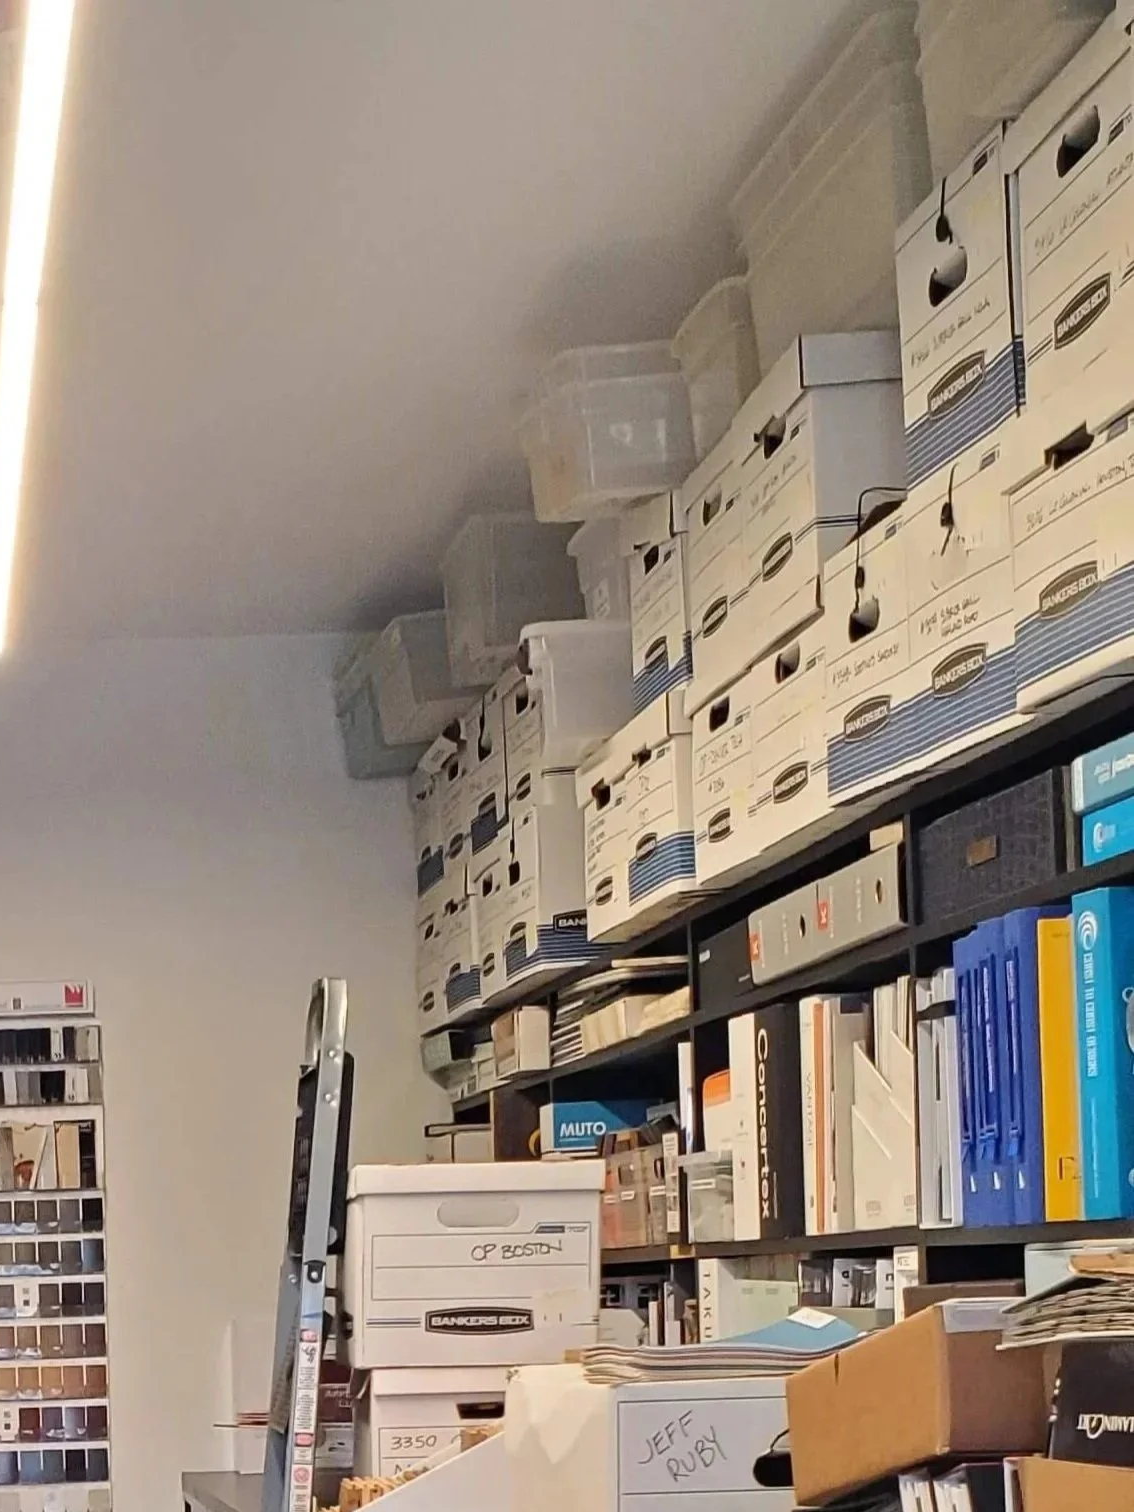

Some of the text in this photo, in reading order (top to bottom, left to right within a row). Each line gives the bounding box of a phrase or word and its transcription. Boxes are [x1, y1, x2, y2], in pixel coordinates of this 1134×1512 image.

[1041, 573, 1099, 612] BANKERS BOX
[559, 1121, 607, 1137] MUTO
[502, 1239, 563, 1260] BOSTON
[431, 1315, 530, 1327] BANKERS BOX
[391, 1434, 438, 1450] 3350
[638, 1409, 693, 1464] JEFF
[666, 1425, 728, 1483] RUBY
